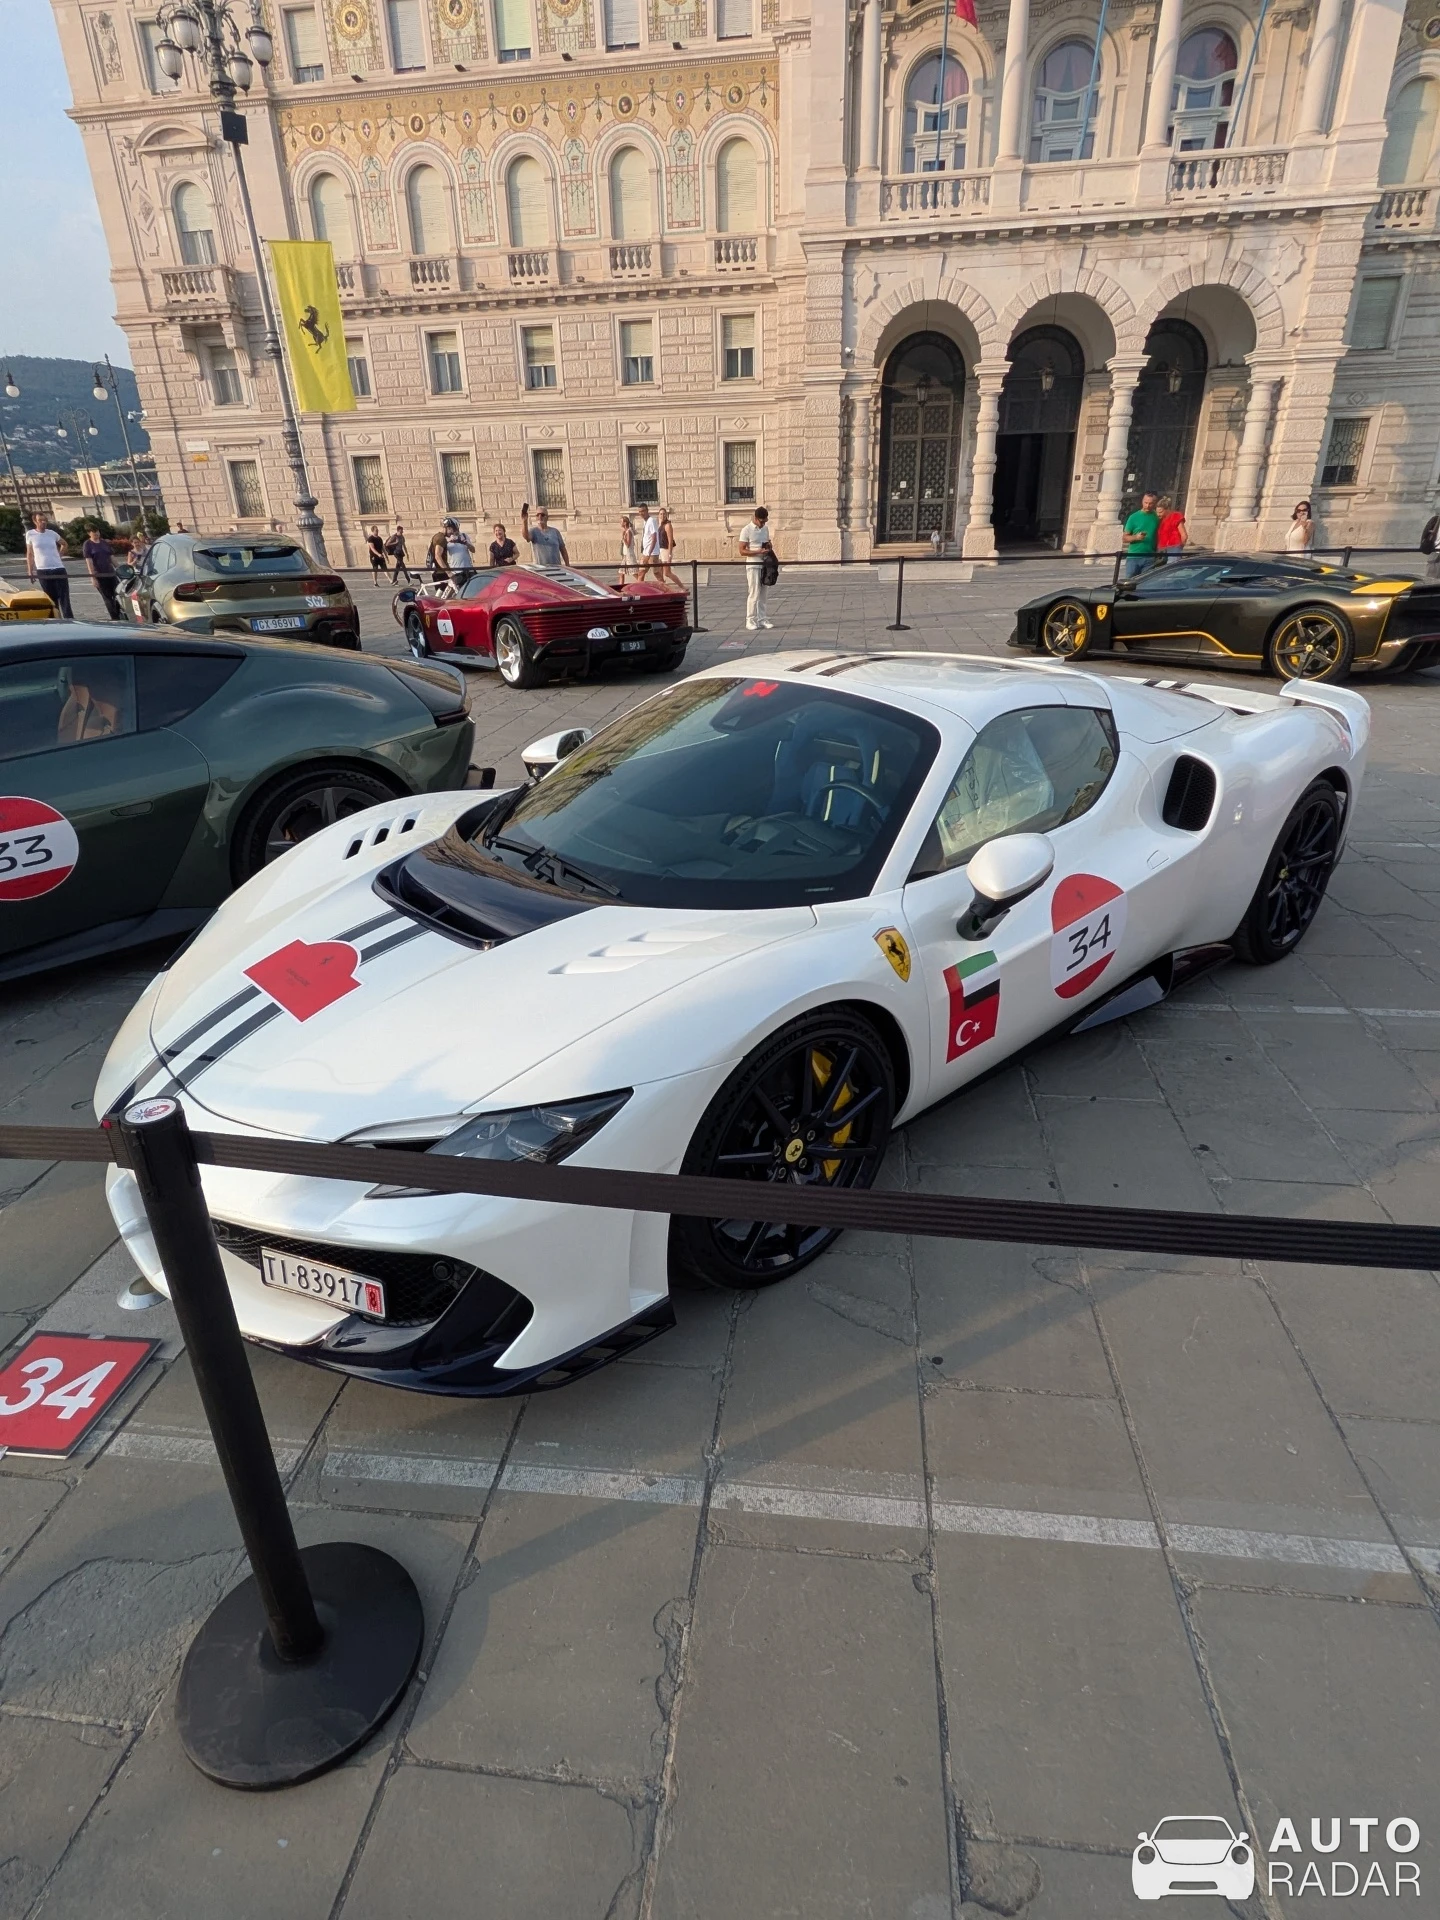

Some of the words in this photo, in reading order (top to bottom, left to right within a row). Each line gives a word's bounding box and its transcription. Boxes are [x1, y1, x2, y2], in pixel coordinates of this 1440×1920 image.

[305, 595, 326, 607] SG2
[442, 622, 449, 633] 1
[1066, 913, 1112, 972] 34
[0, 1357, 118, 1420] 34
